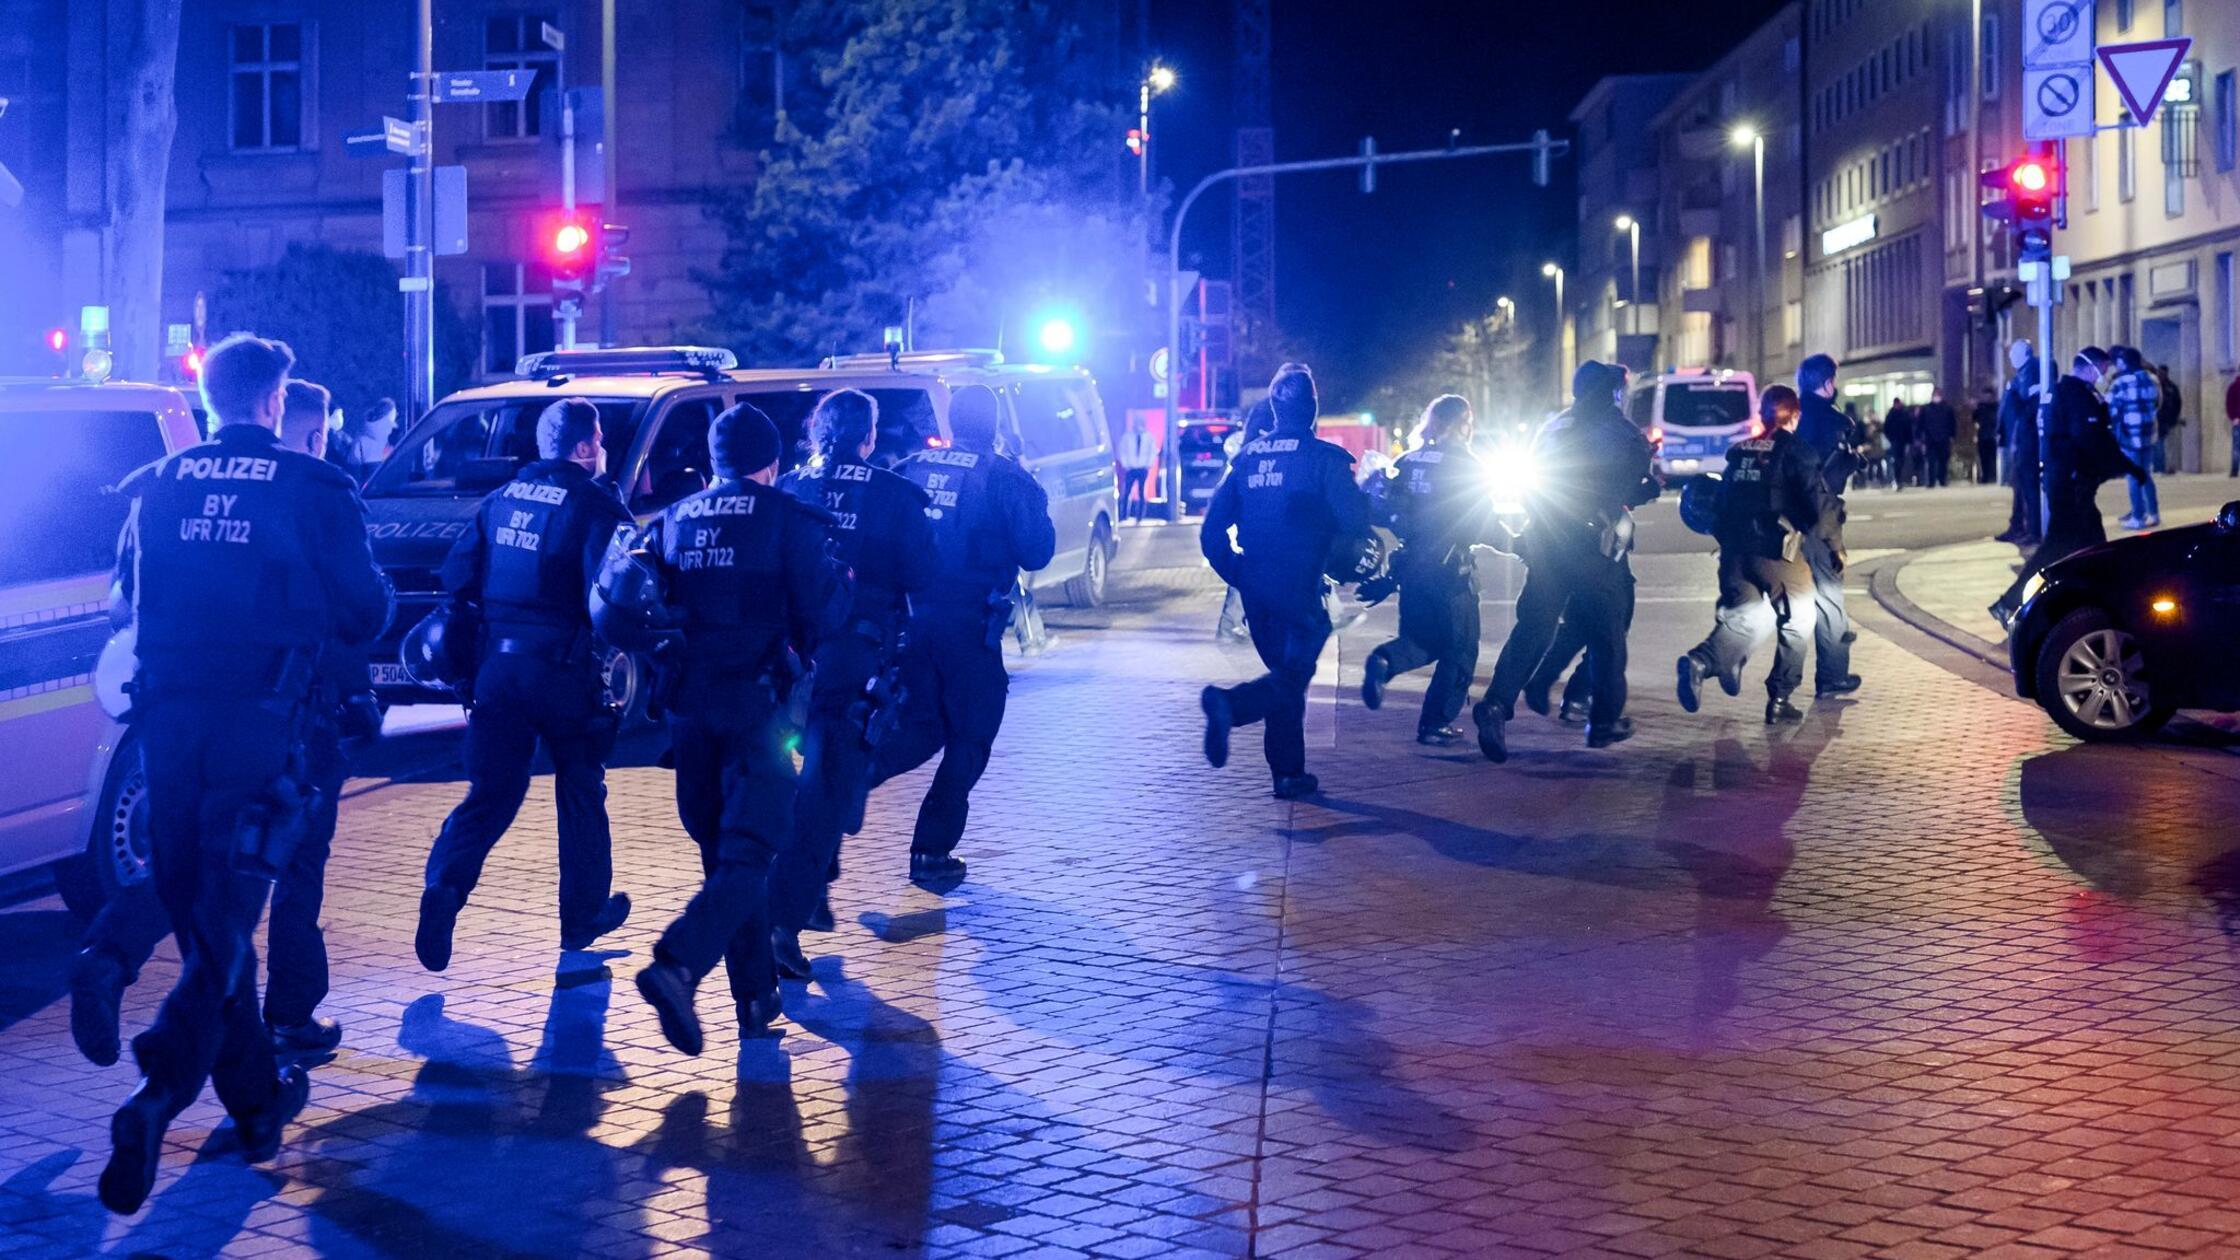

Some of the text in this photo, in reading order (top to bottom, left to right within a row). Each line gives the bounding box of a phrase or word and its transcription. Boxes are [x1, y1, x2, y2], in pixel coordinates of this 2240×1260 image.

[1247, 439, 1299, 455] POLIZEI
[176, 457, 278, 481] POLIZEI
[916, 449, 979, 469] POLIZEI
[1258, 459, 1276, 473] BY
[798, 465, 873, 482] POIZEI
[927, 473, 950, 490] BY
[503, 482, 568, 506] POLIZEI
[203, 494, 238, 517] BY
[676, 496, 756, 522] POLIZEI
[181, 518, 251, 543] UFR 7122
[509, 510, 534, 530] BY
[515, 530, 540, 551] 7122
[695, 527, 722, 548] BY
[679, 547, 735, 572] UFR 7122
